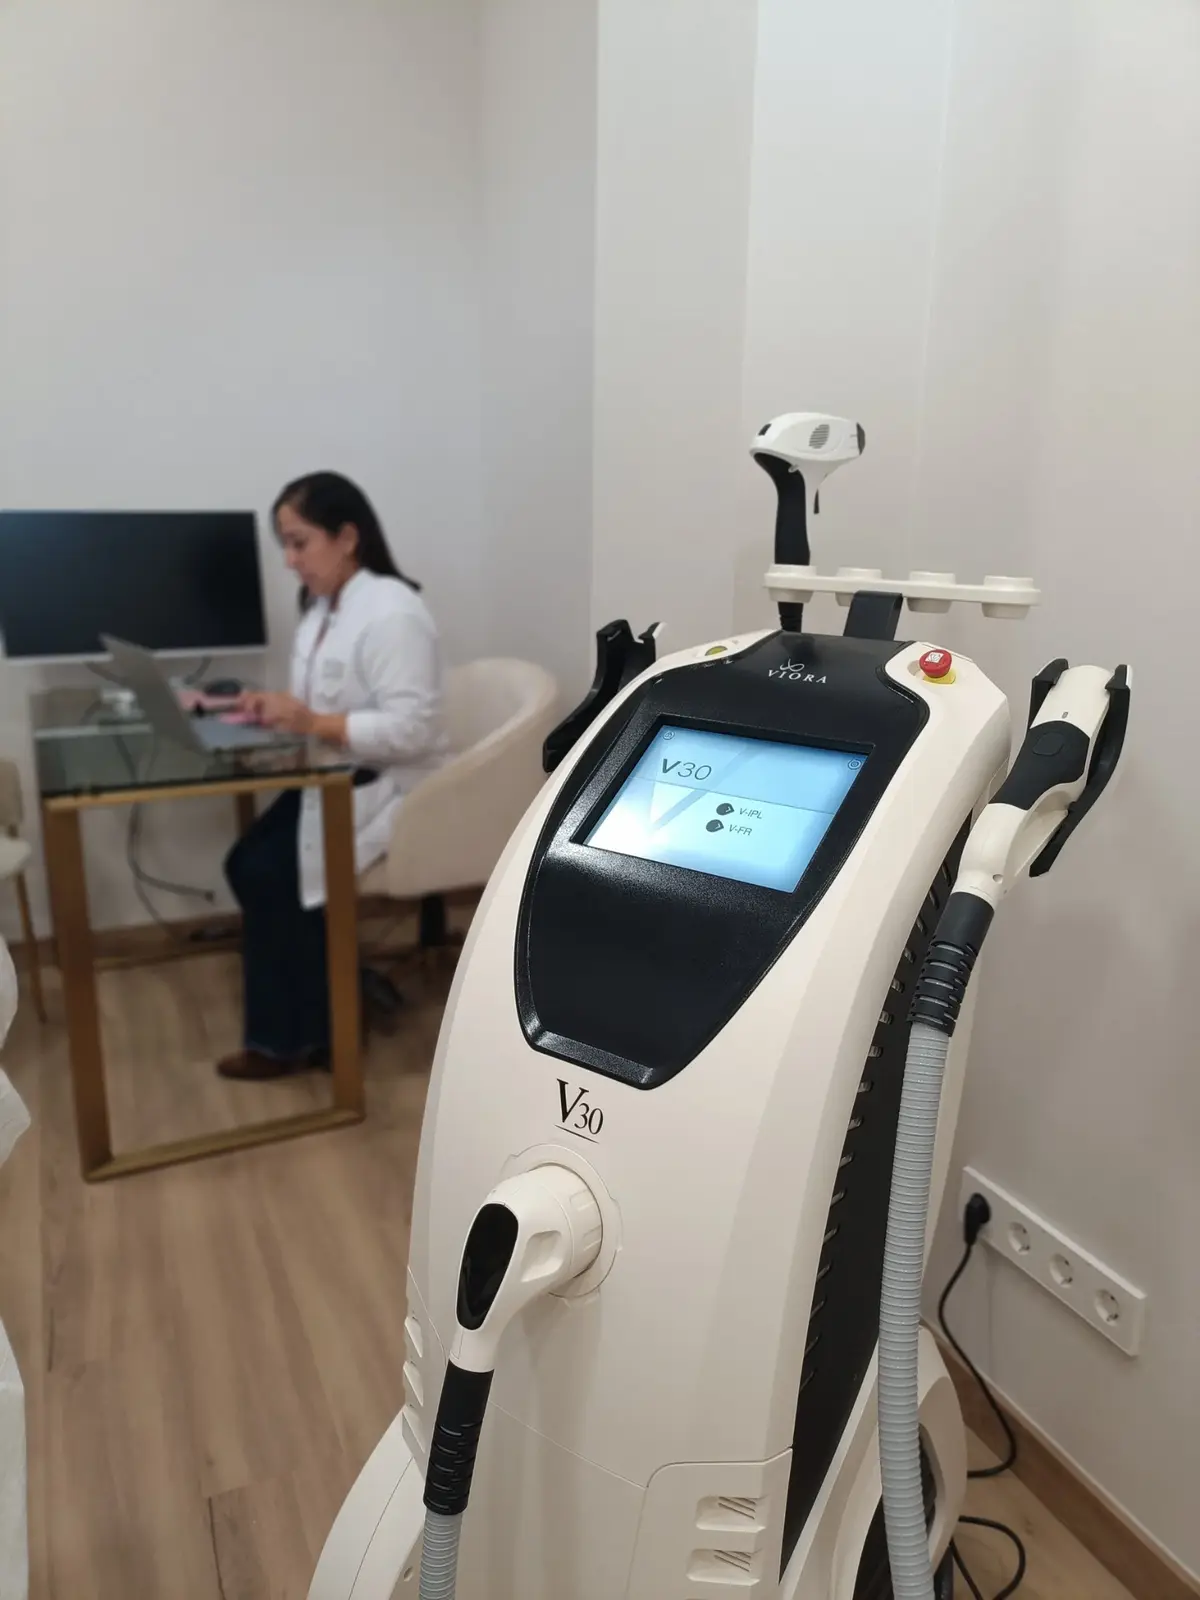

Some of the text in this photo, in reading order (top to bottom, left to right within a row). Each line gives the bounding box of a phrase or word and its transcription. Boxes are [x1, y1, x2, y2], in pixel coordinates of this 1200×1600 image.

[768, 669, 827, 684] VIORA
[661, 758, 712, 780] V30
[739, 807, 763, 819] V-IPL
[728, 824, 752, 836] V-FR
[556, 1078, 604, 1135] V30
